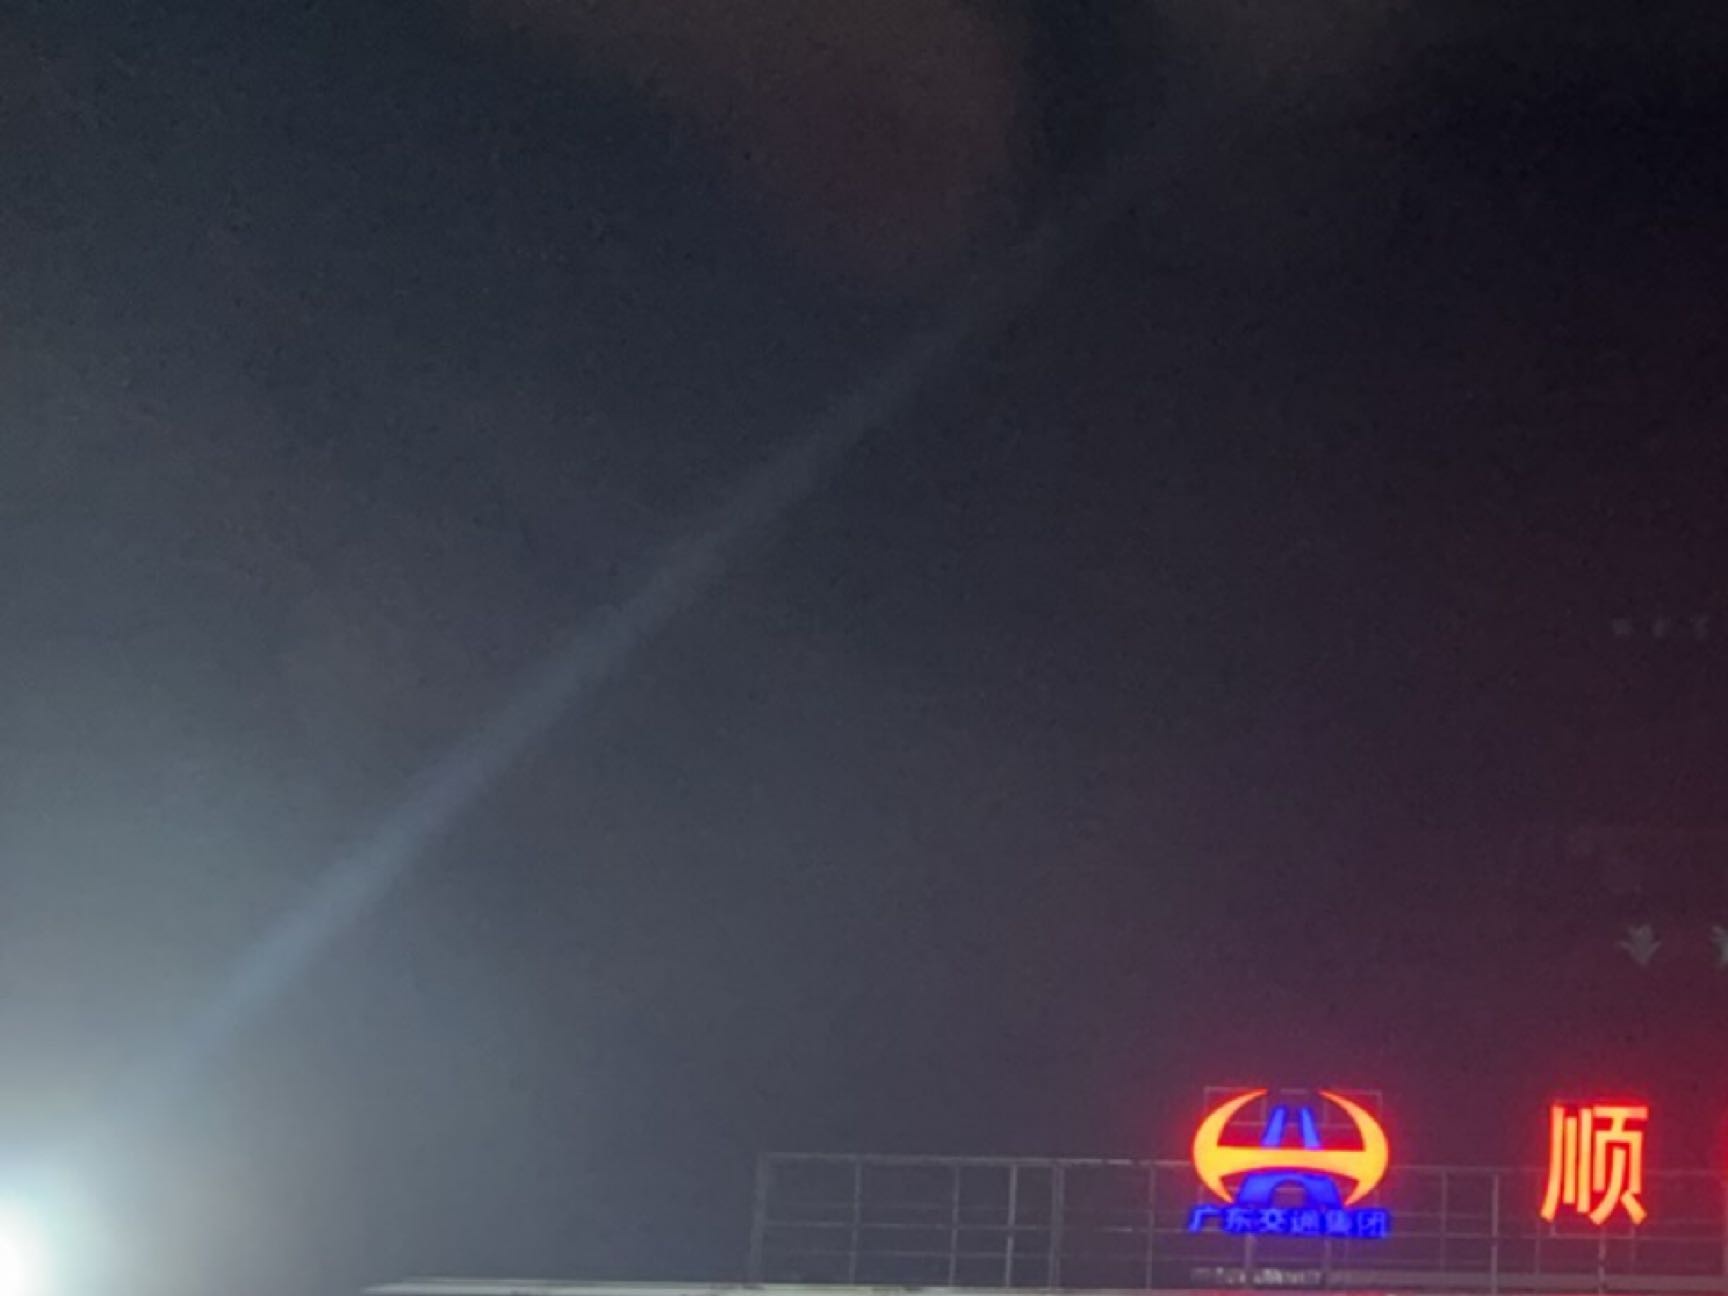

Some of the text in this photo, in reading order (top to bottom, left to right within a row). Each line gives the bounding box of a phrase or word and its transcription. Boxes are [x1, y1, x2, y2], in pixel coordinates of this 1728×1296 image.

[1188, 1205, 1388, 1238] 广东交通集团
